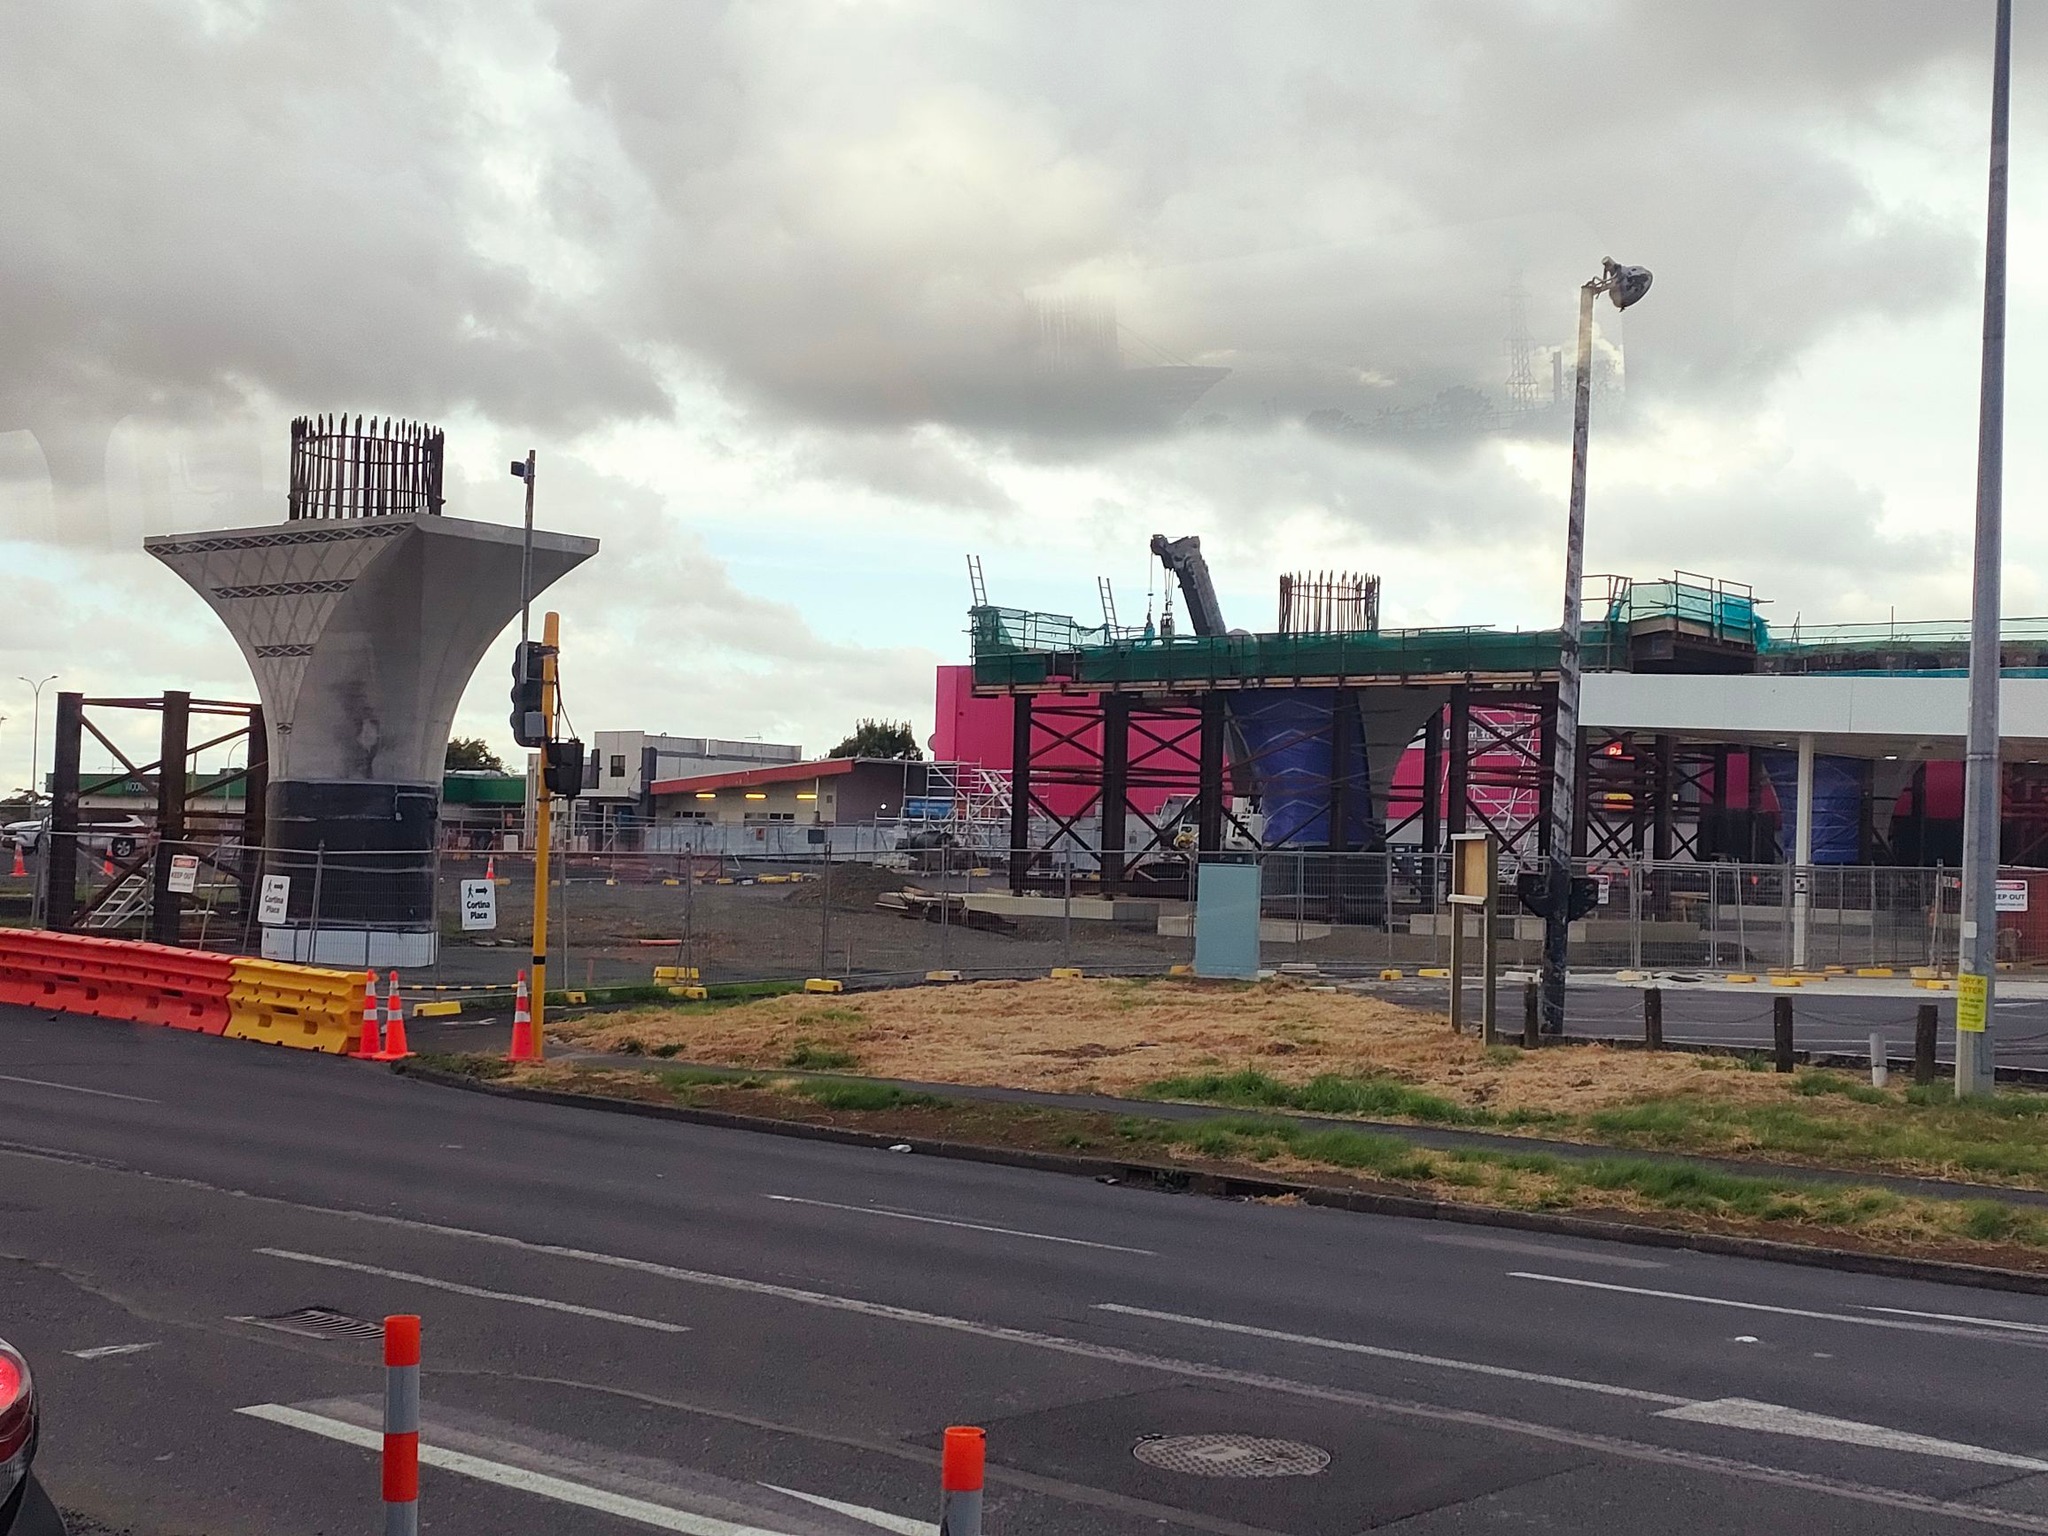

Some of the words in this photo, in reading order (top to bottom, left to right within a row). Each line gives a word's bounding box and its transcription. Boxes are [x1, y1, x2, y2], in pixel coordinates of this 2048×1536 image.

[265, 895, 284, 904] Cortina
[466, 900, 491, 909] Cortina
[266, 905, 280, 914] Place
[470, 911, 488, 920] Place
